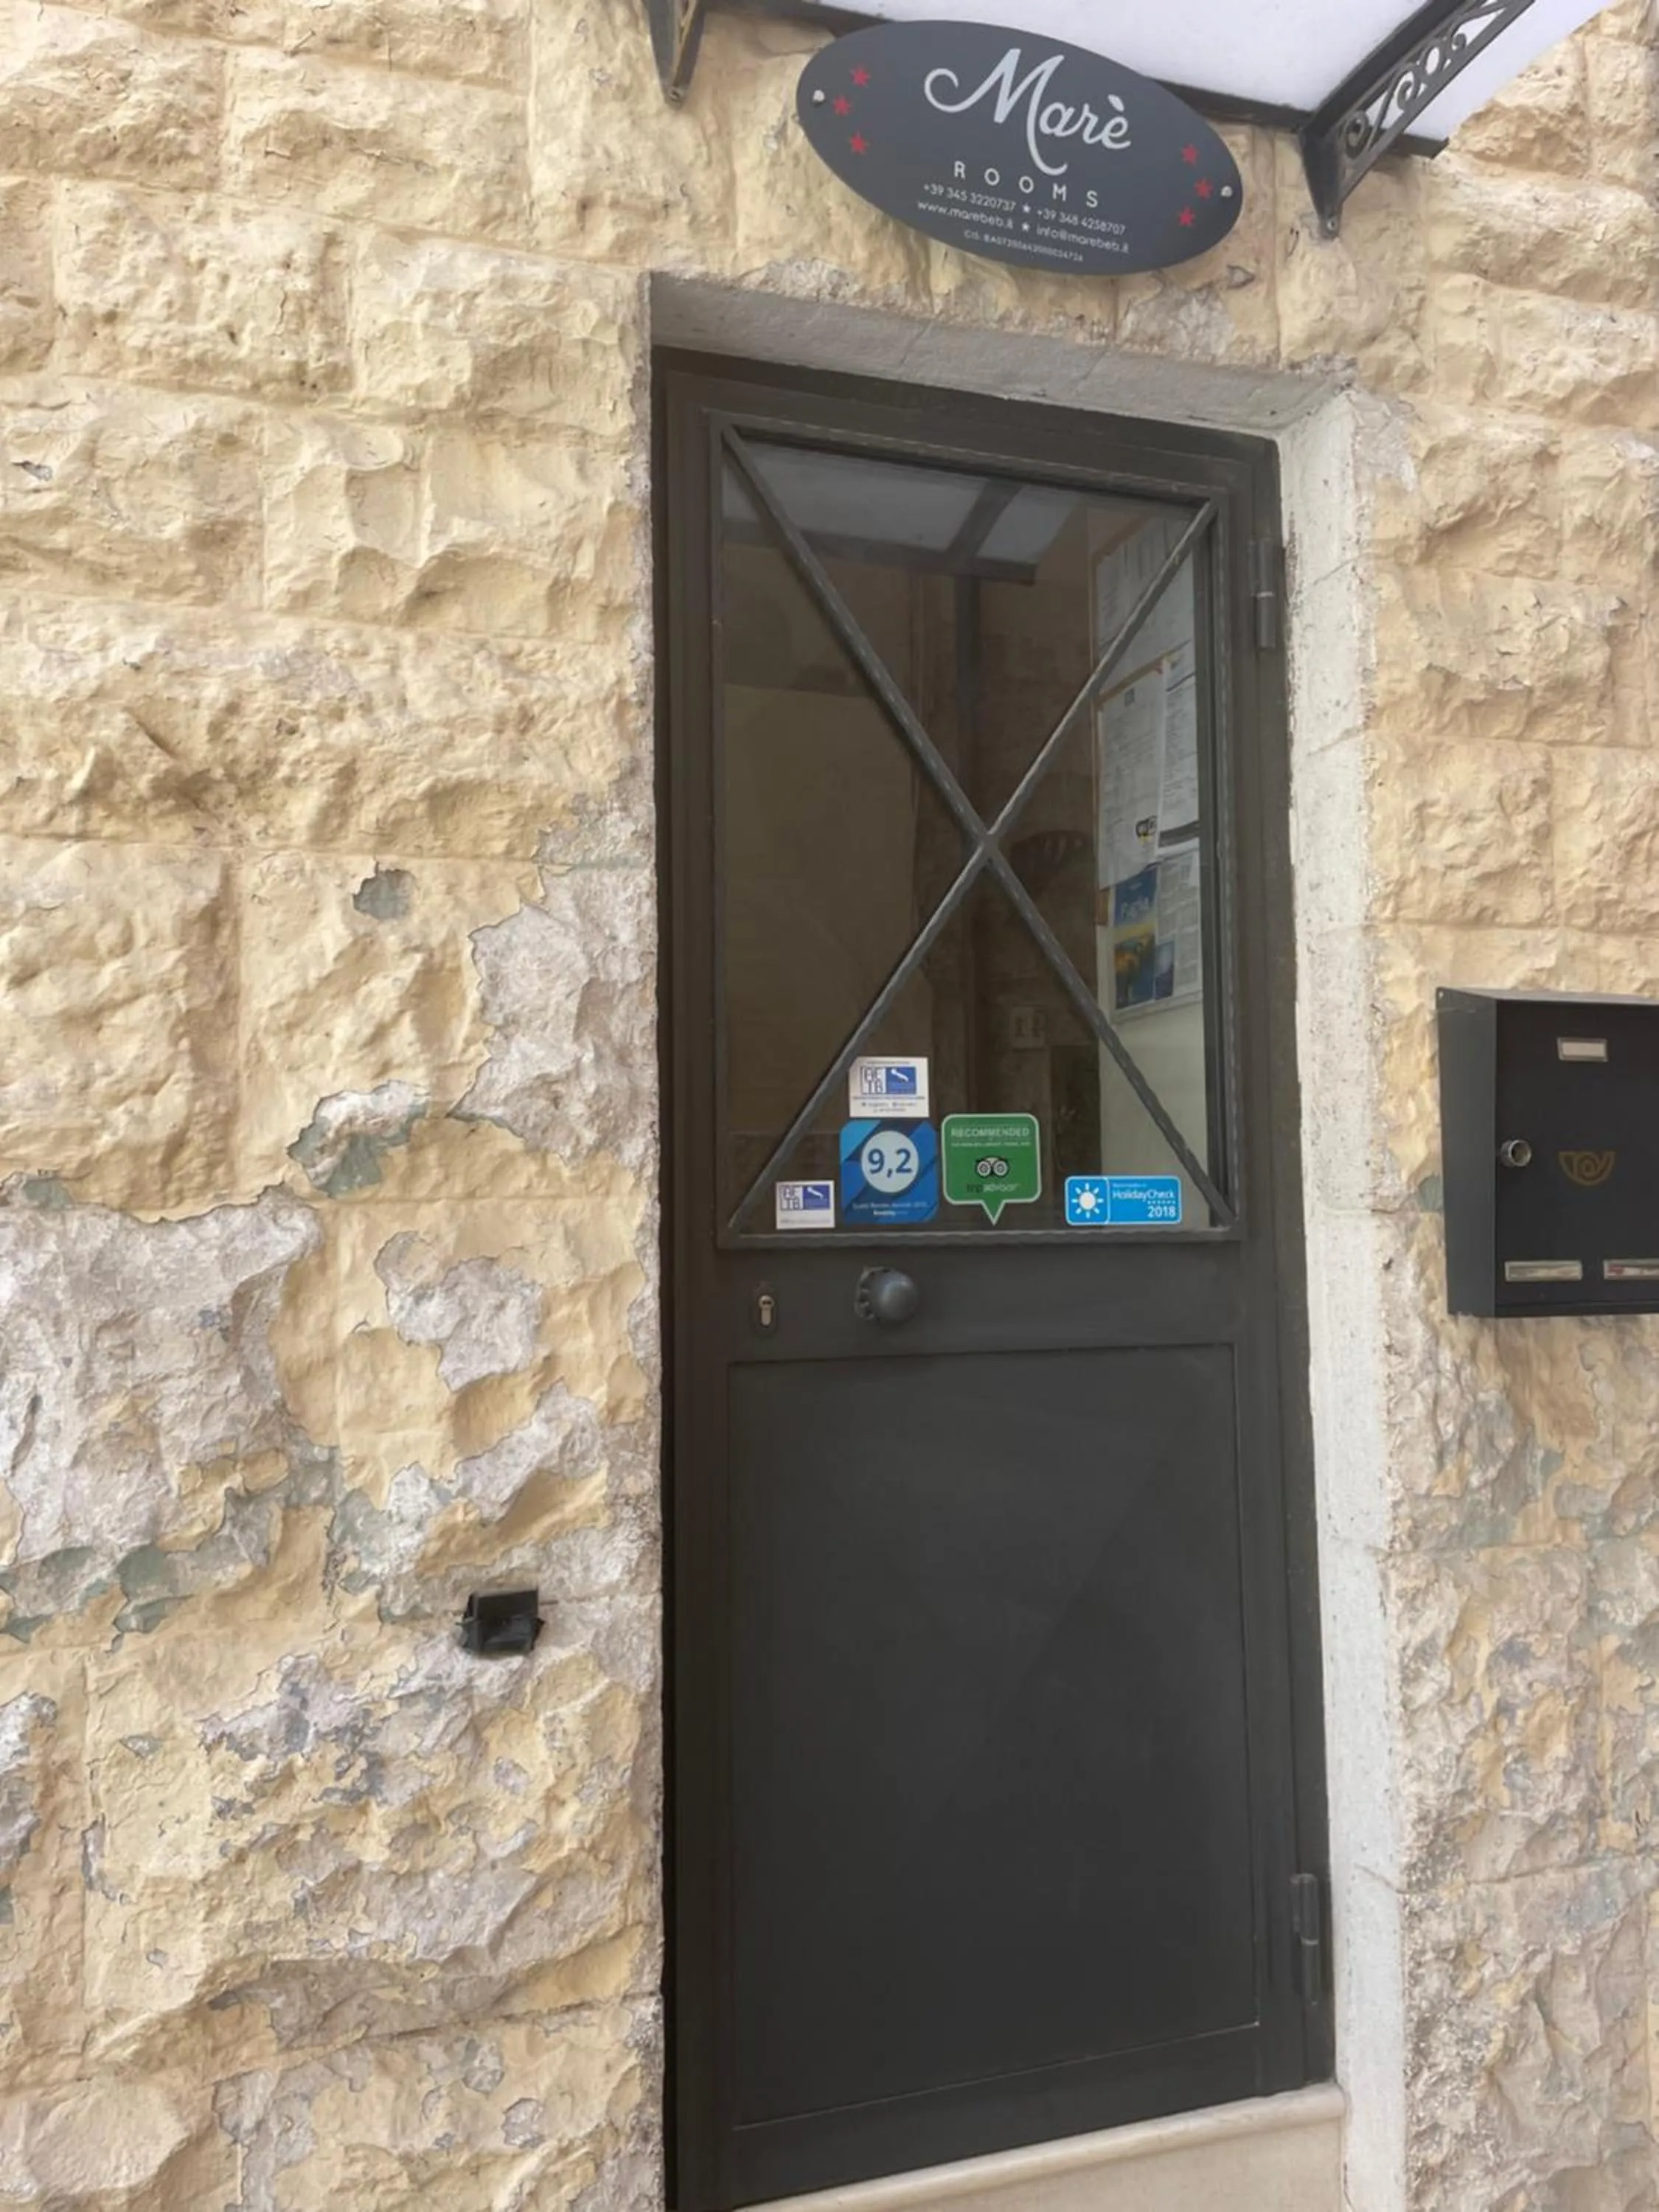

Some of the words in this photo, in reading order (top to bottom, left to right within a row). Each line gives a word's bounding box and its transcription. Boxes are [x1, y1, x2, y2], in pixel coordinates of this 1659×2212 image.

[924, 48, 1131, 175] Marè
[954, 161, 1099, 208] ROOMS
[923, 184, 945, 196] +39
[947, 187, 967, 201] 345
[970, 192, 1017, 212] 3220737
[1037, 207, 1057, 220] +39
[950, 1127, 1031, 1137] RECOMMENDED
[868, 1148, 914, 1179] 9,2
[1112, 1189, 1175, 1203] HolidayCheck
[1147, 1206, 1177, 1218] 2018
